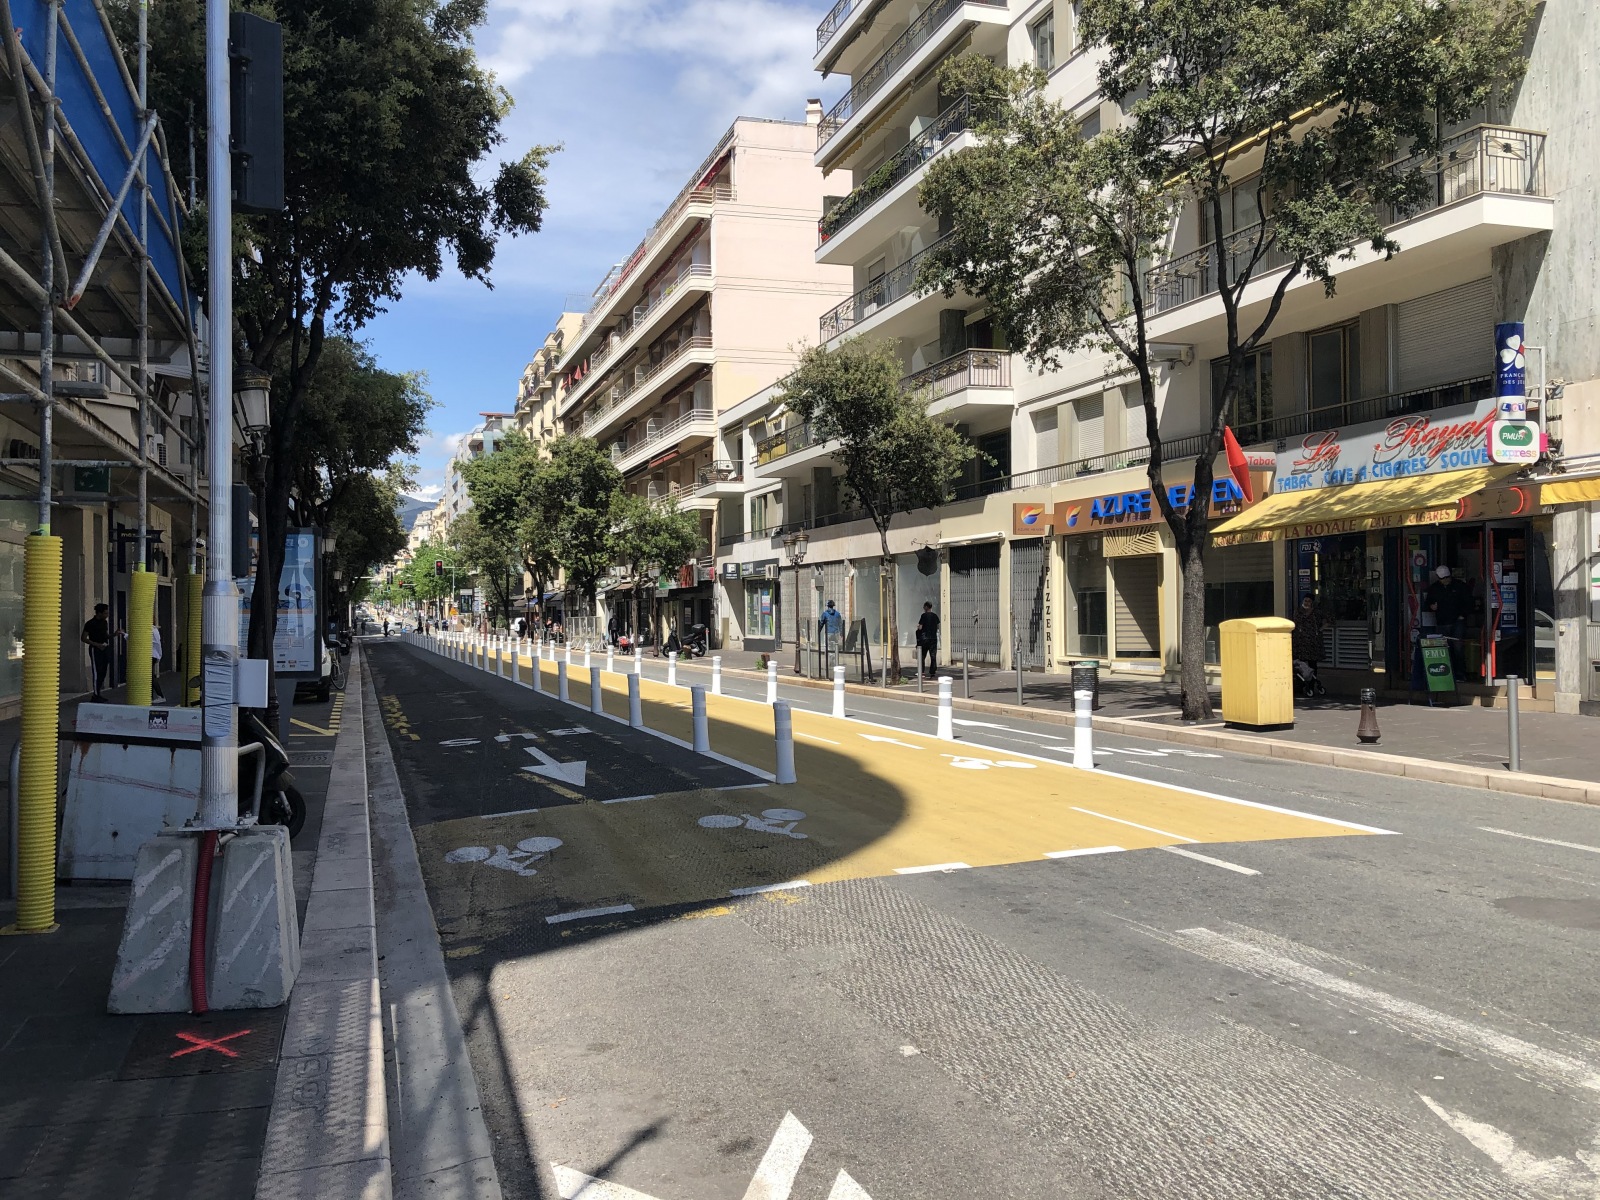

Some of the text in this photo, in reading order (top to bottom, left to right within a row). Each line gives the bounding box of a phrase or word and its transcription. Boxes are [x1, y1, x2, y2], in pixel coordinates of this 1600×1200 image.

[1502, 432, 1519, 440] PMU
[1247, 455, 1276, 466] Tabac
[1293, 430, 1342, 467] La
[1495, 449, 1537, 460] express
[1277, 473, 1313, 493] TABAC
[1324, 467, 1354, 485] CAVE
[1371, 456, 1427, 478] CIGARES
[1090, 490, 1152, 519] AZURE
[1284, 525, 1300, 538] LA
[1304, 517, 1357, 536] ROYALE
[1370, 515, 1393, 528] CAVE
[1407, 511, 1451, 524] CIGARES
[1045, 566, 1053, 668] PIZZERIA
[1425, 650, 1446, 658] PMU
[438, 726, 593, 747] BUS
